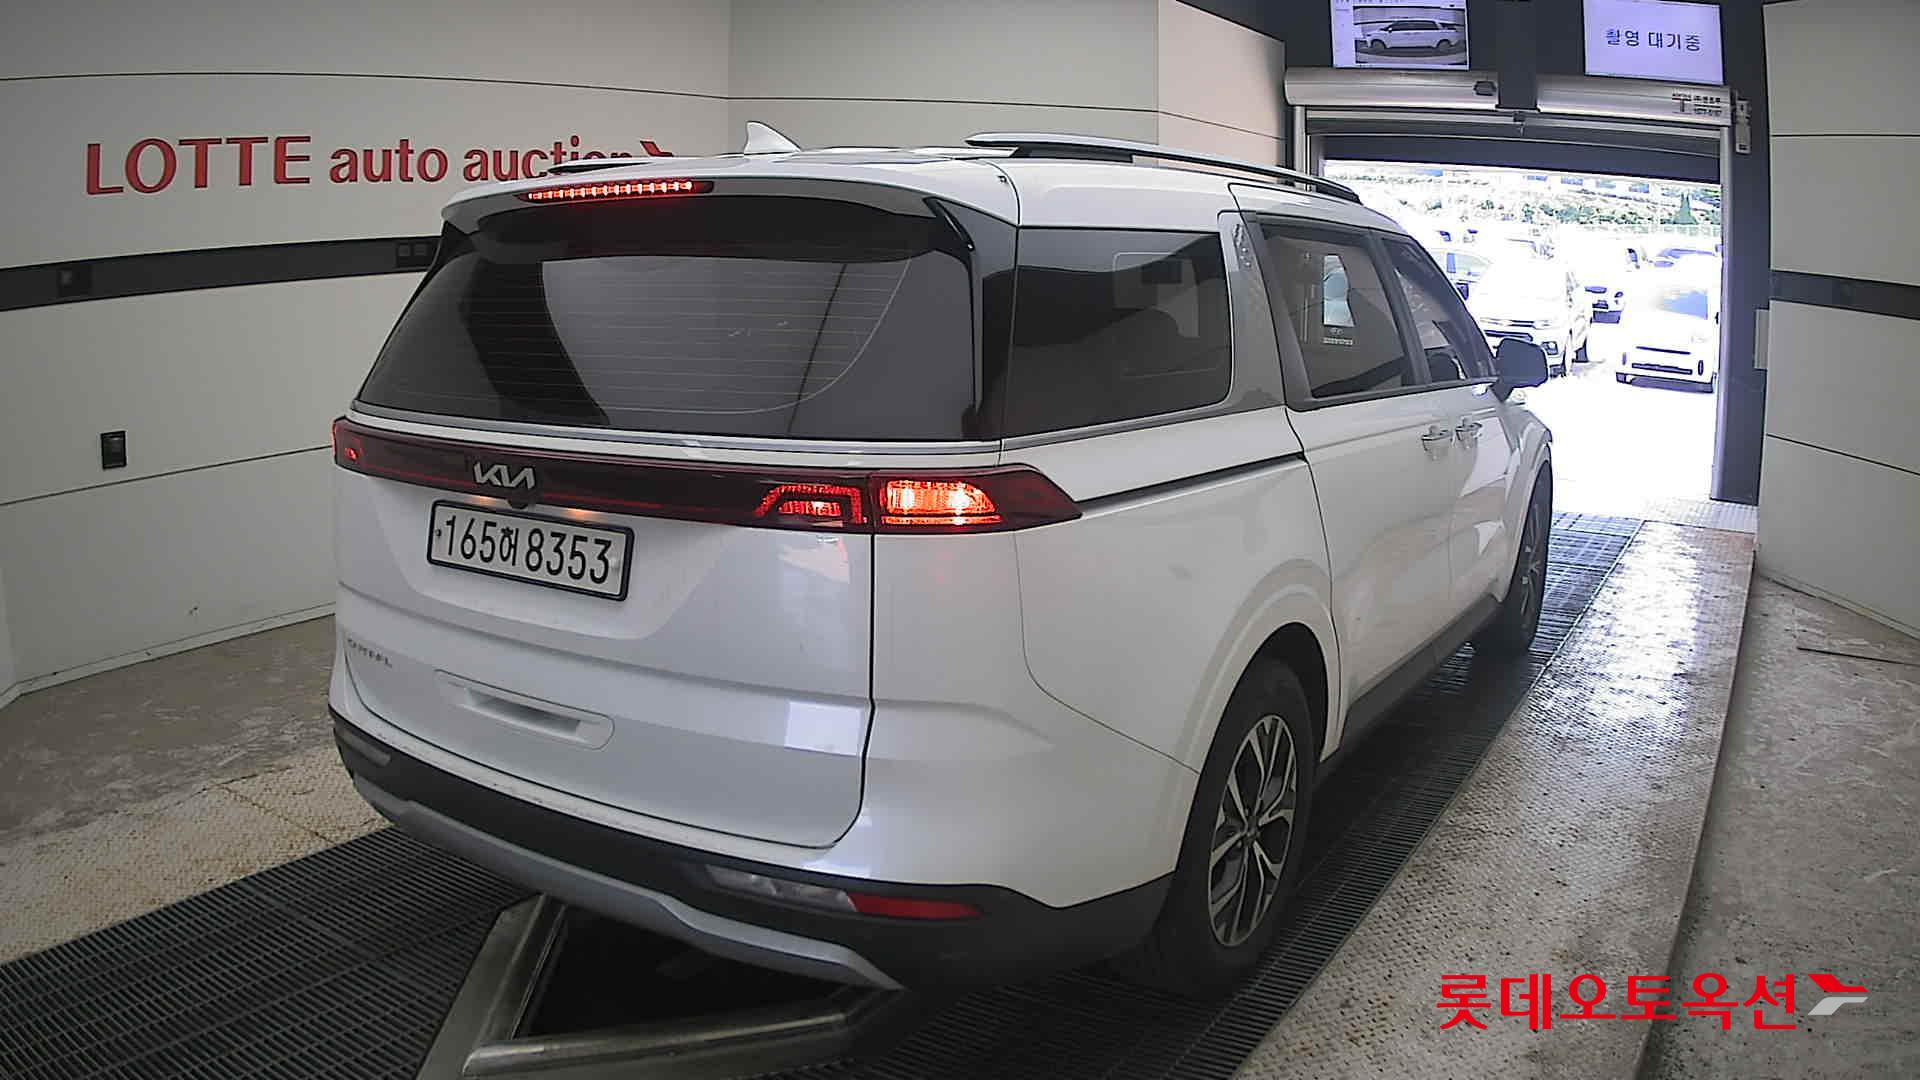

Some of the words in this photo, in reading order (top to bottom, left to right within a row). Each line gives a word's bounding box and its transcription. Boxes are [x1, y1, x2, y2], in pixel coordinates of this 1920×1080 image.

[1648, 31, 1701, 52] 대기중
[86, 136, 311, 195] LOTTE
[329, 138, 449, 184] auto
